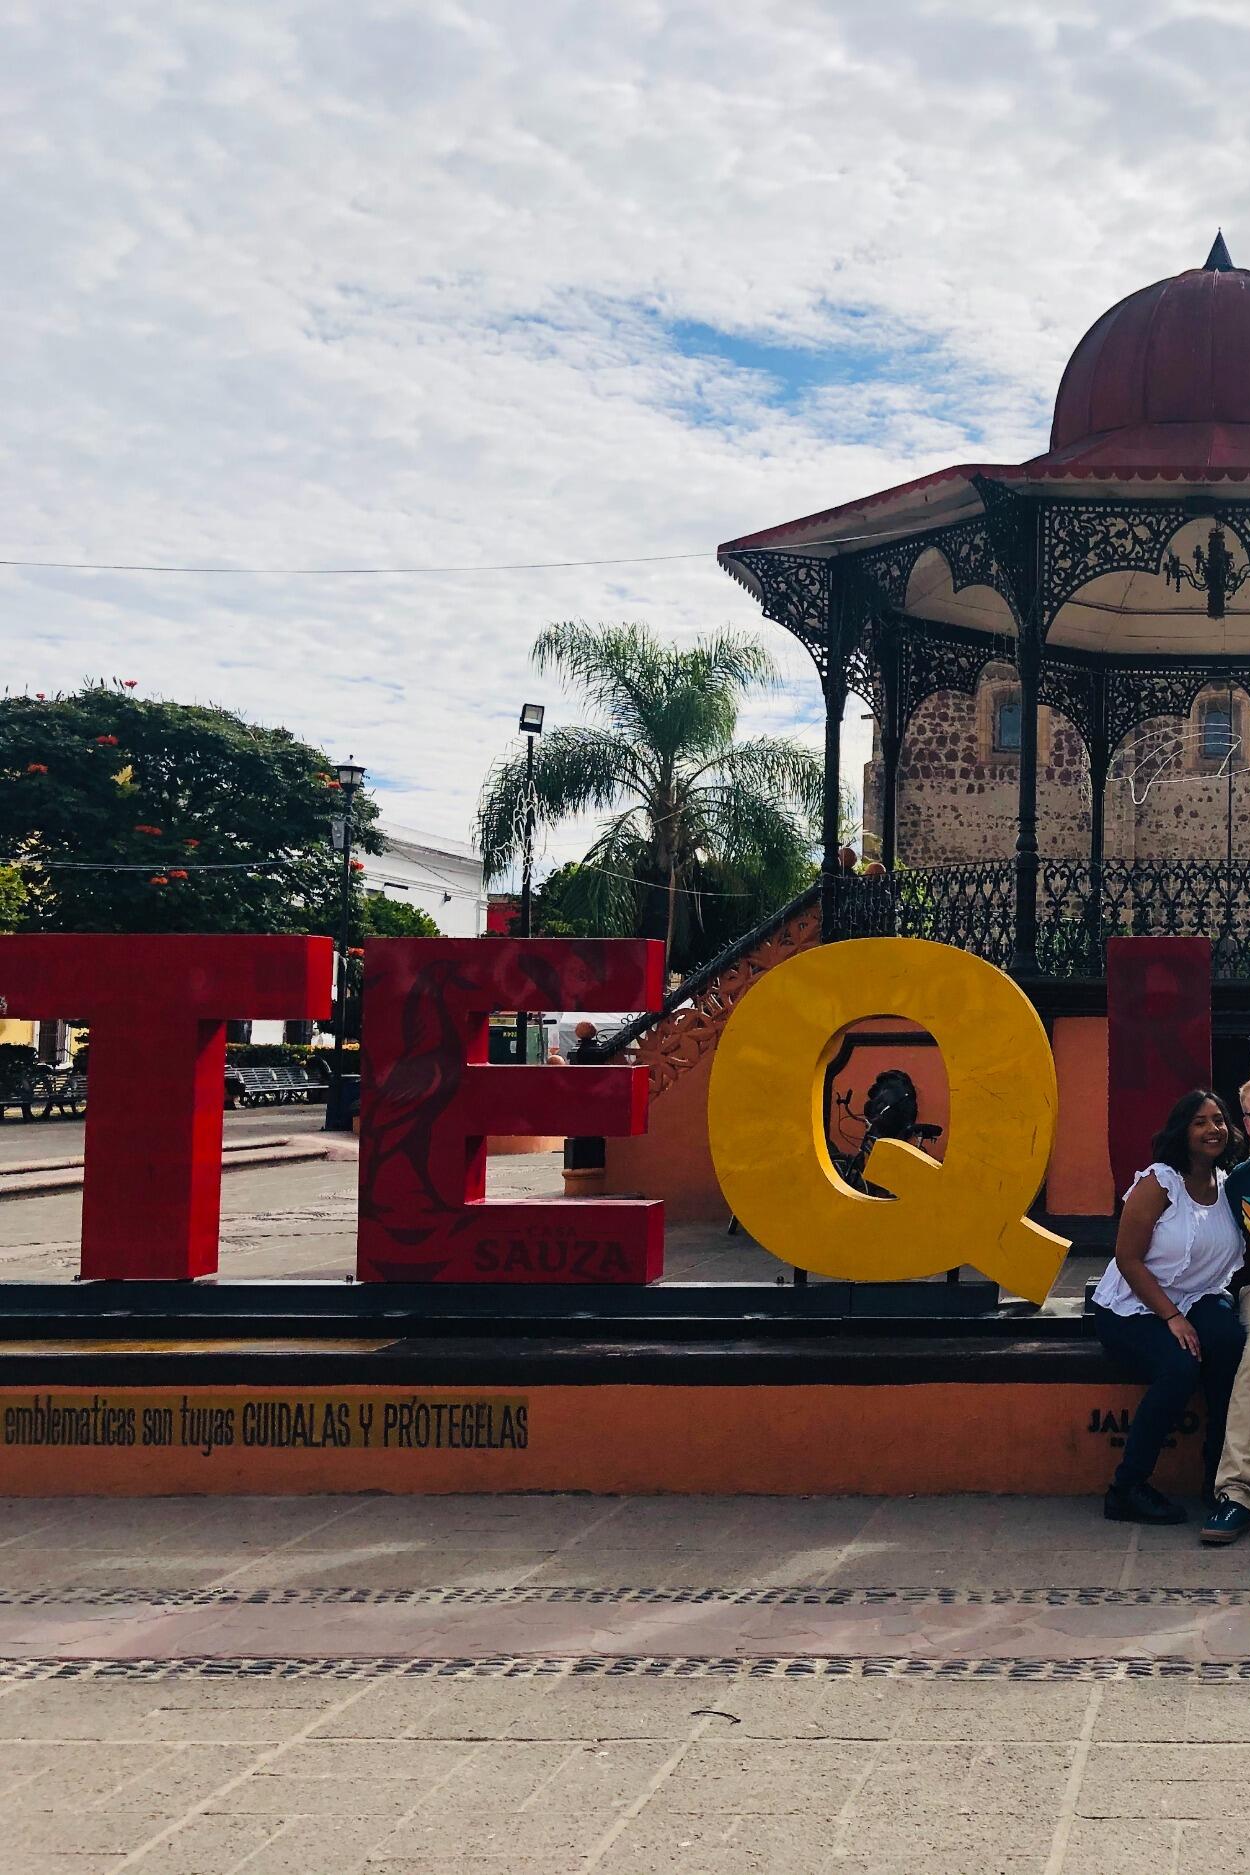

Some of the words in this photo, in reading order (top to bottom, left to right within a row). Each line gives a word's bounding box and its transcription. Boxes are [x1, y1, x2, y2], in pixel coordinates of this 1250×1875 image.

[474, 1238, 632, 1280] SAUZA
[142, 1408, 173, 1446] son
[180, 1395, 235, 1456] tuyas
[243, 1402, 350, 1447] CUIDALAS
[359, 1403, 373, 1447] Y
